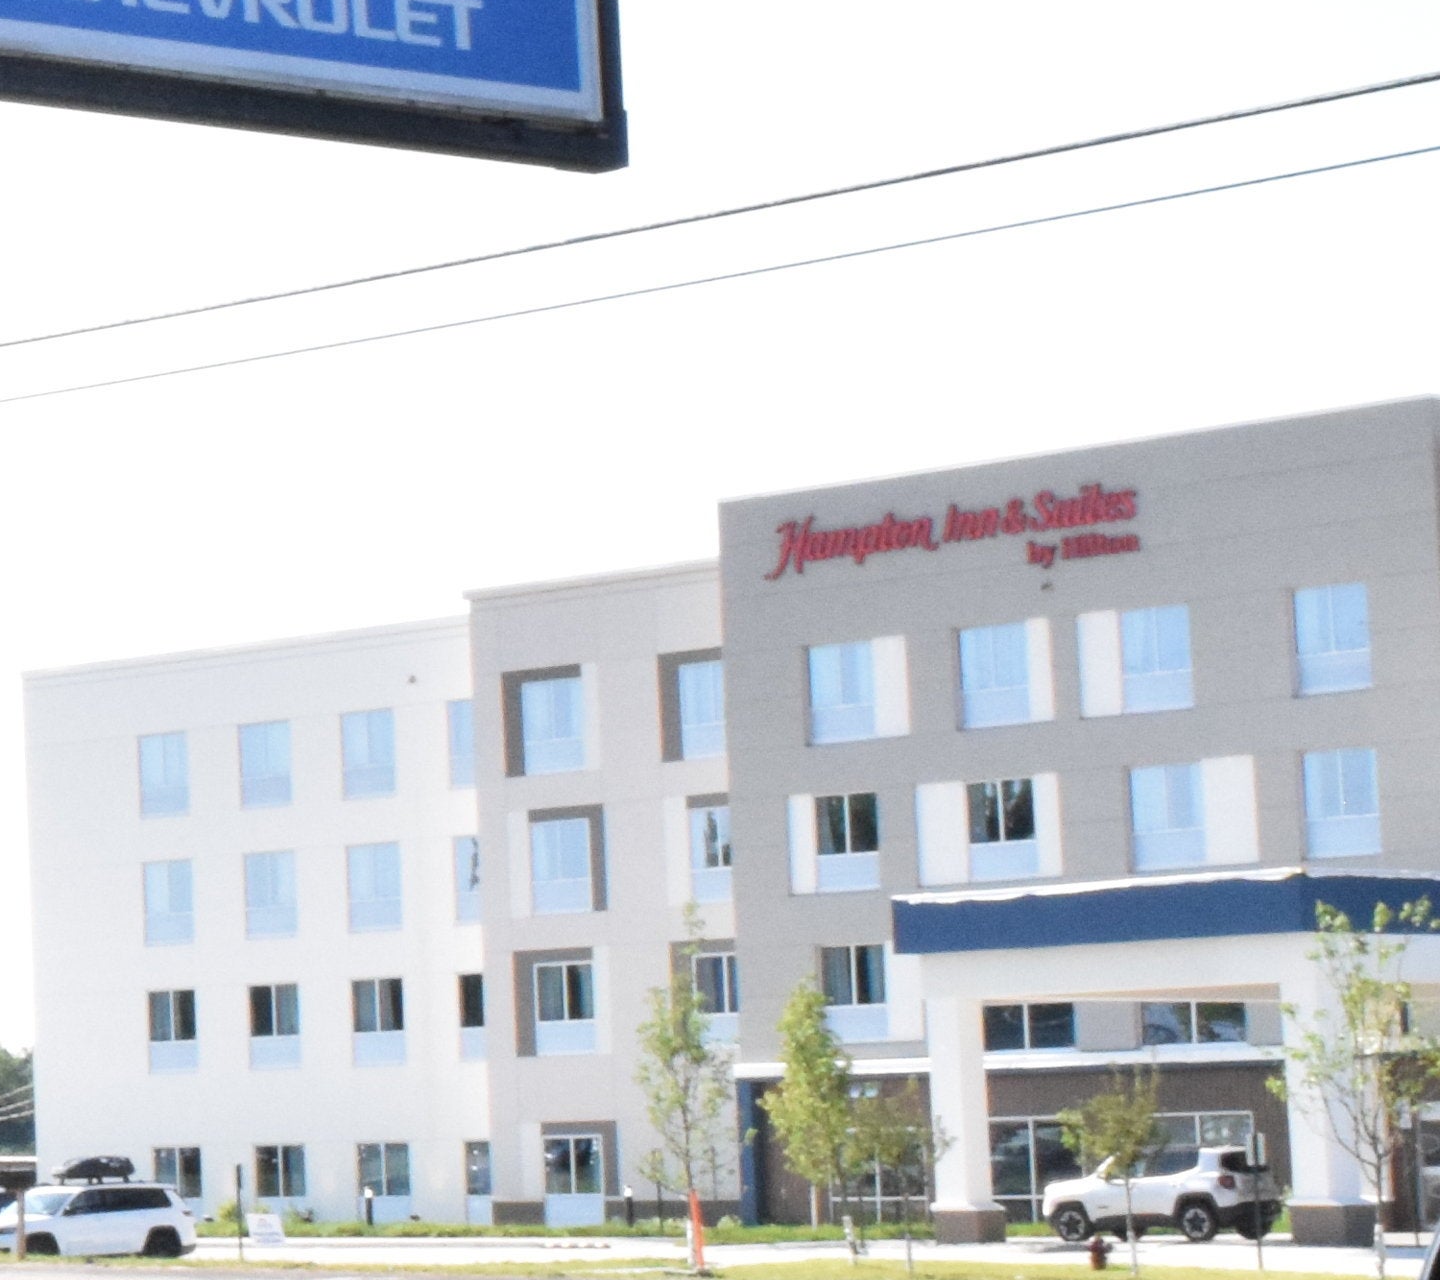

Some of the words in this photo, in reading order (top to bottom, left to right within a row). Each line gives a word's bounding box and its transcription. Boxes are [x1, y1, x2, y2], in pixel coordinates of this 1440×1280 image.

[763, 512, 939, 581] Hampton
[942, 503, 999, 543] Inn
[1001, 498, 1027, 535] &
[1027, 483, 1137, 532] Suites
[1026, 540, 1057, 569] by
